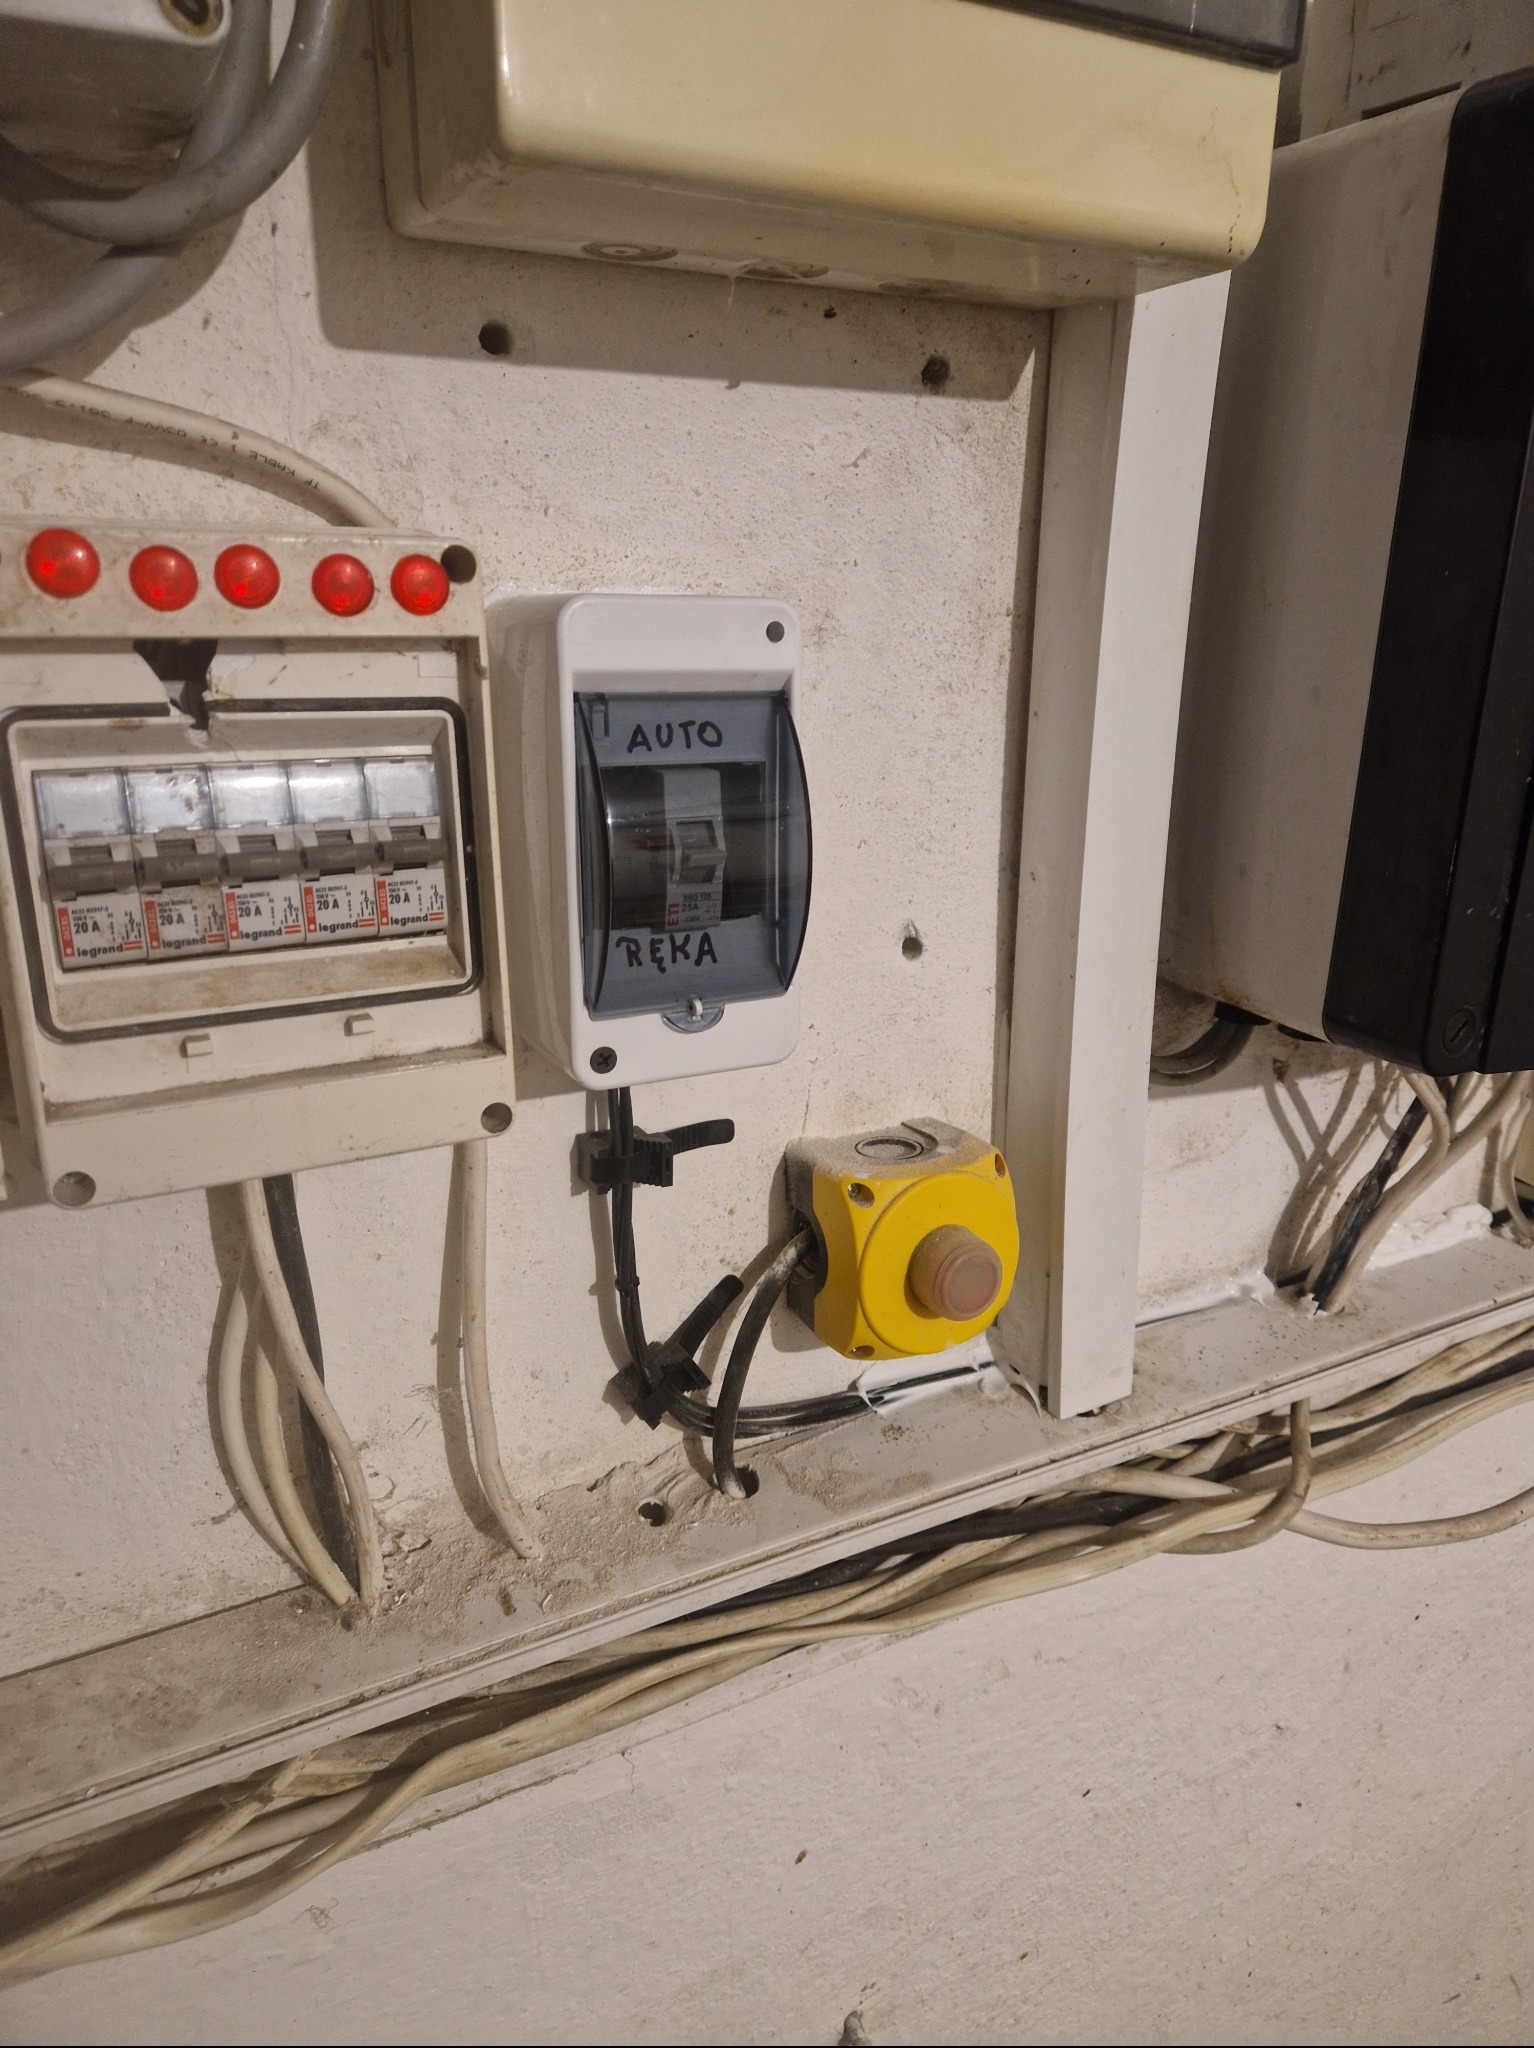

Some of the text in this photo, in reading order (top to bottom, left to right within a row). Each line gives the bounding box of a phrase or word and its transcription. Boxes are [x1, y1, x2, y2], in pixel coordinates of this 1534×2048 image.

[249, 450, 296, 477] KABLE
[626, 720, 723, 753] AUTO
[316, 899, 330, 910] 20
[331, 898, 340, 909] A
[389, 893, 401, 904] 20
[403, 892, 411, 903] A
[237, 905, 251, 917] 20
[253, 905, 262, 916] A
[682, 902, 699, 913] 25A
[159, 913, 185, 926] 20 A
[318, 919, 359, 933] legrand
[390, 913, 429, 926] legrand
[73, 921, 100, 934] 20 A
[240, 927, 283, 942] legrand
[162, 934, 206, 949] legrand
[77, 943, 123, 958] legrand
[615, 931, 718, 974] RĘKA
